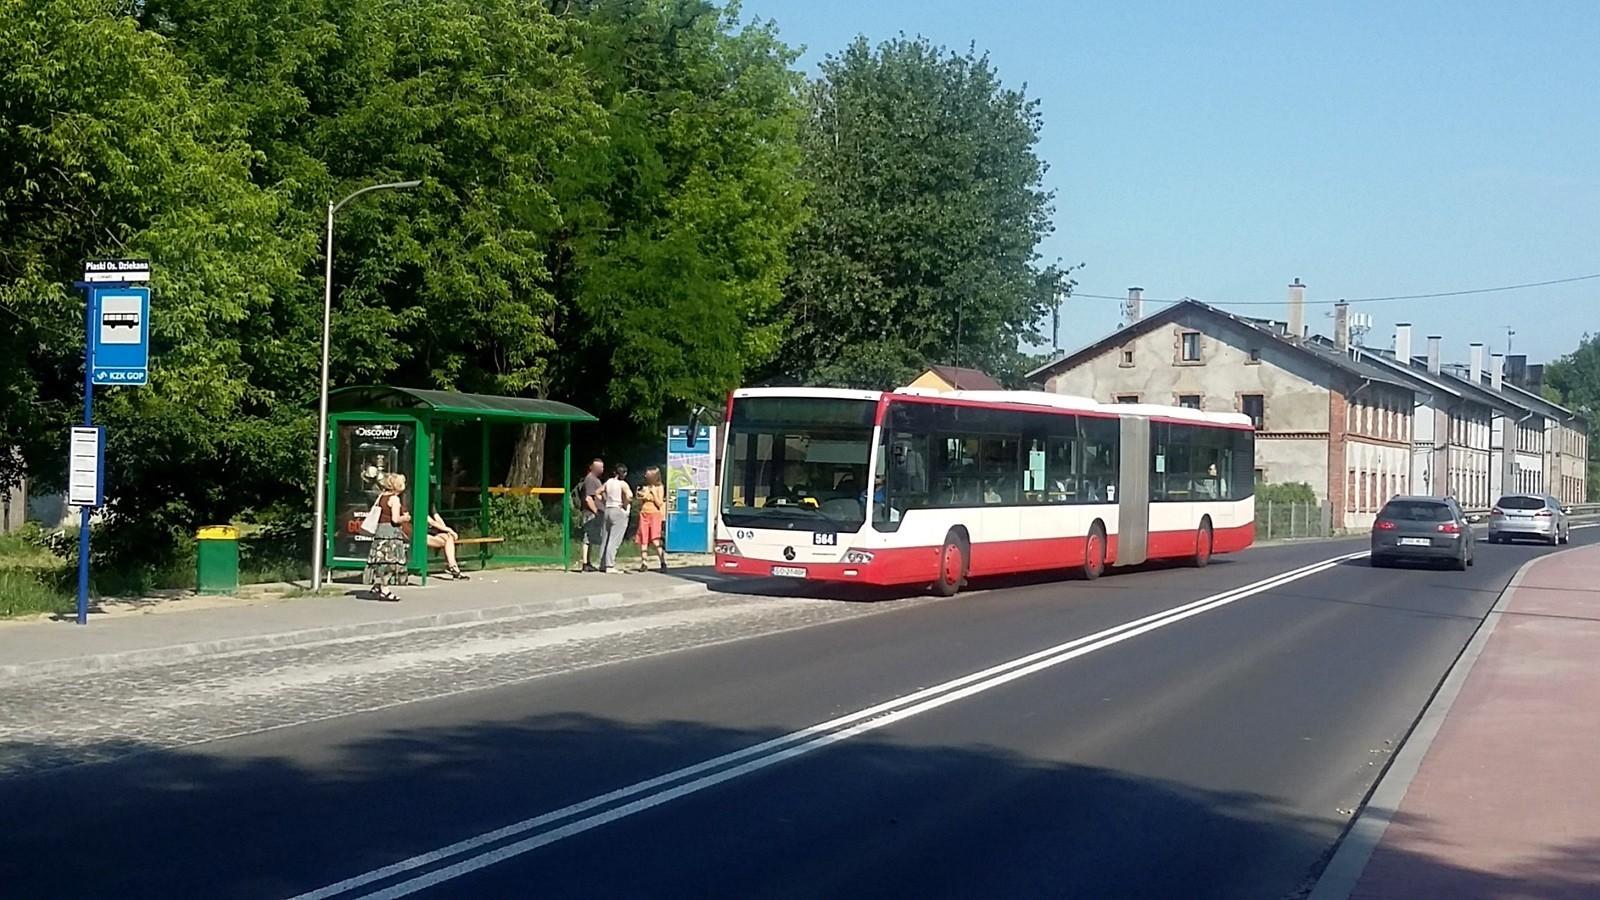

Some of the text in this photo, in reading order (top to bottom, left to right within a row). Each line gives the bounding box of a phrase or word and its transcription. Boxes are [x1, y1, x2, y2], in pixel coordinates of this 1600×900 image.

[86, 261, 149, 270] Piaski Os. Dziekana
[110, 372, 144, 380] KZK GOP
[355, 427, 399, 439] Discovery
